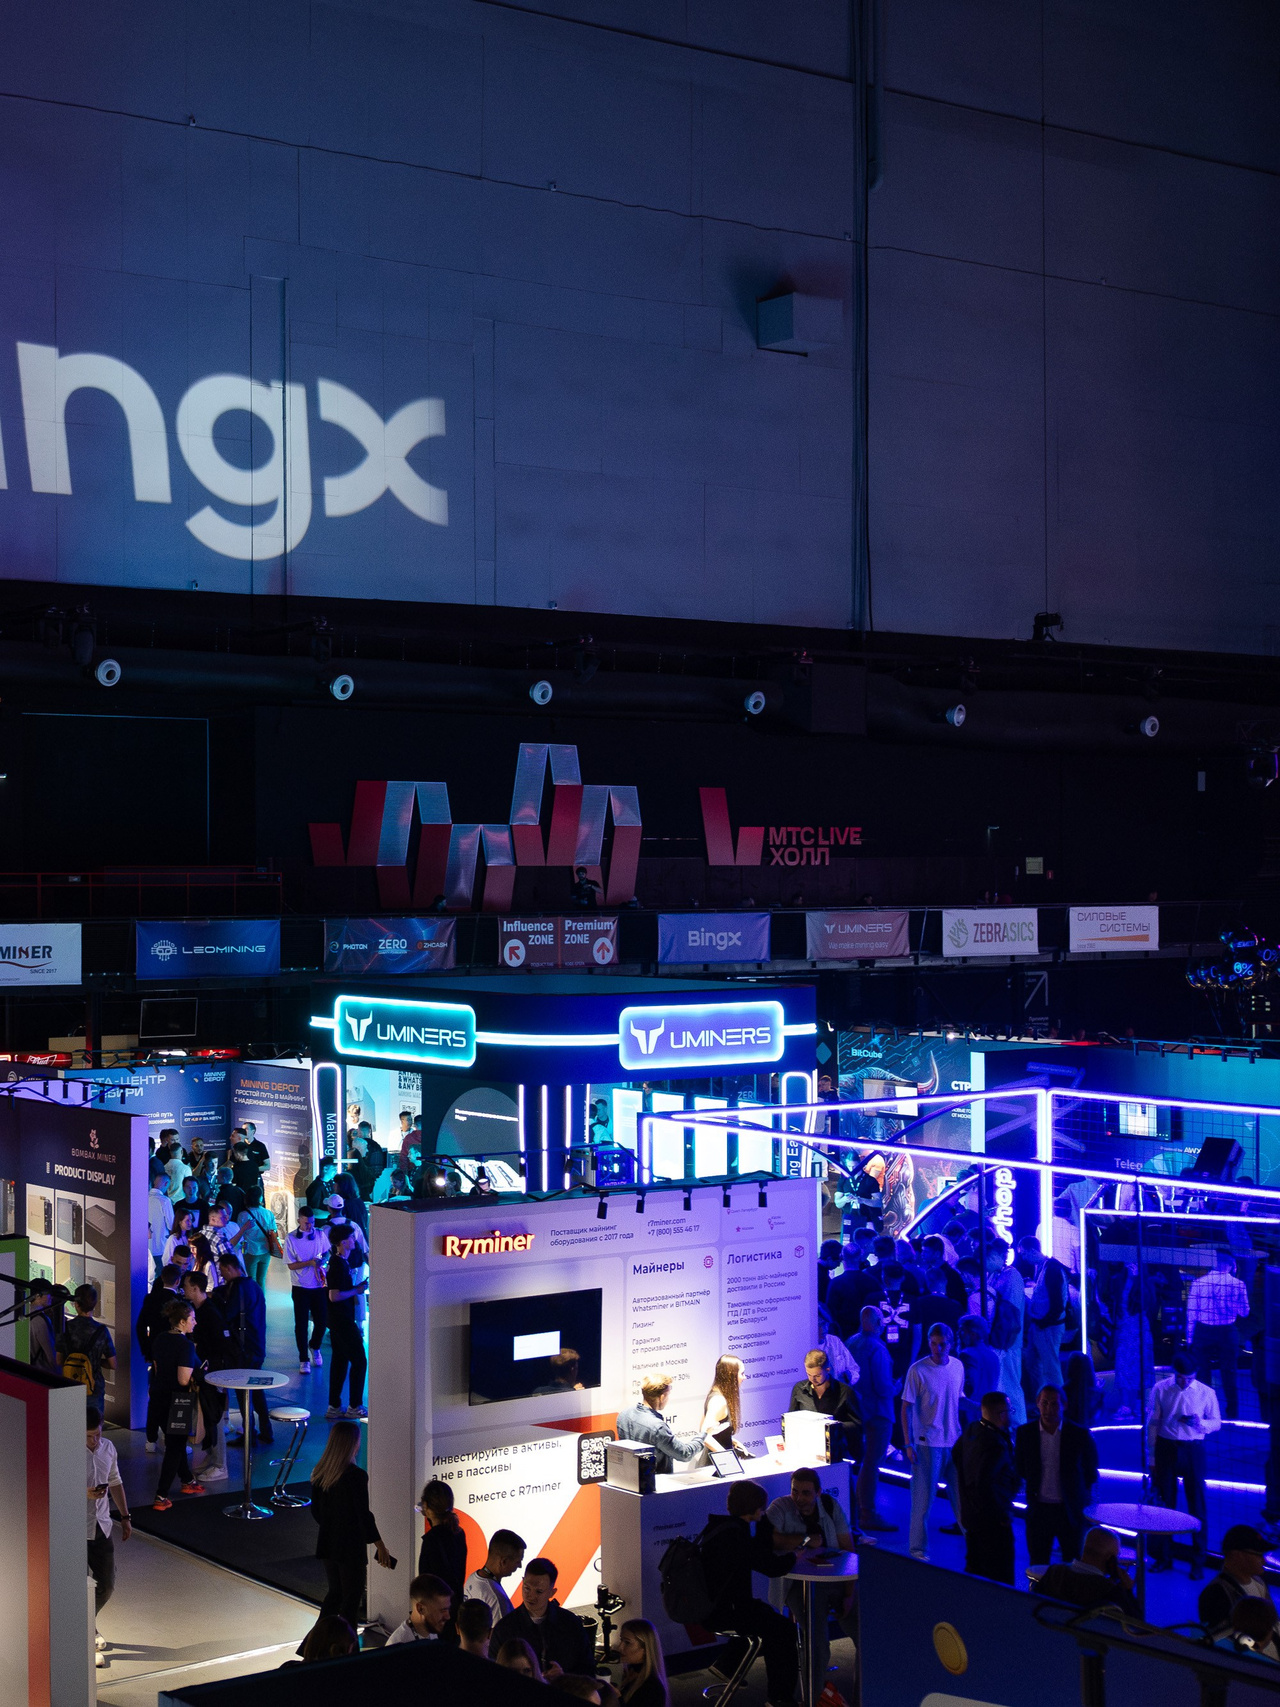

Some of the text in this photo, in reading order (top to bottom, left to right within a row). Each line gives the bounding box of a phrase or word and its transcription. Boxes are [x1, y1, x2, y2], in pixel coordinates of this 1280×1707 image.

[818, 826, 863, 846] LIVE
[770, 847, 830, 867] ХОЛЛ
[1077, 911, 1127, 921] СИЛОВЫЕ
[503, 920, 554, 932] Influence
[564, 919, 614, 931] Premium
[837, 923, 893, 934] UMINERS
[1099, 922, 1151, 932] СИСТЕМЫ
[564, 933, 590, 944] ZONE
[973, 921, 1035, 943] ZEBRASICS
[378, 938, 408, 950] ZERO
[528, 934, 554, 945] ZONE
[687, 927, 742, 951] Bingx
[182, 944, 266, 955] LEOMINING
[342, 943, 368, 951] PHOTON
[377, 1023, 468, 1048] UMINERS
[670, 1027, 772, 1049] UMINERS
[851, 1047, 883, 1059] BitCube
[240, 1078, 300, 1093] MINING DEPOT
[235, 1089, 306, 1102] ПРОСТОЙ ПУТЬ МАЙНИНГ
[238, 1097, 308, 1111] НАДЕЖНЫМИ РЕШЕНИЯМИ
[324, 1112, 337, 1156] Making
[71, 1147, 117, 1164] BOMBAX MINER
[54, 1163, 116, 1186] PRODUCT DISPLAY
[647, 1218, 687, 1227] r7miner.com
[550, 1224, 618, 1237] Поставщик майнинг
[656, 1226, 684, 1237] (800) 555
[443, 1230, 535, 1260] R7miner
[550, 1231, 634, 1246] оборудования 2017 года
[727, 1250, 782, 1265] Логистика
[633, 1260, 685, 1275] Майнеры
[727, 1270, 799, 1285] 2000 тонн asic-майнеров
[727, 1280, 786, 1293] доставили Россию
[632, 1291, 684, 1304] Авторизованный
[727, 1293, 802, 1309] Таможенное оформление
[632, 1299, 701, 1313] Whatsminer BITMAIN
[757, 1305, 778, 1314] России
[632, 1320, 655, 1330] Лизинг
[739, 1315, 768, 1326] Беларуси
[632, 1336, 661, 1346] Гарантия
[728, 1330, 776, 1342] Фиксированный
[640, 1341, 687, 1355] производителя
[728, 1339, 770, 1351] срок доставки
[632, 1357, 689, 1371] Наличие Москве
[767, 1354, 783, 1364] груза
[752, 1369, 775, 1380] каждую
[776, 1366, 799, 1376] неделю
[432, 1440, 562, 1467] Инвестируйте в активы,
[441, 1462, 512, 1481] не в пассивы
[468, 1481, 562, 1504] Вместе R7miner
